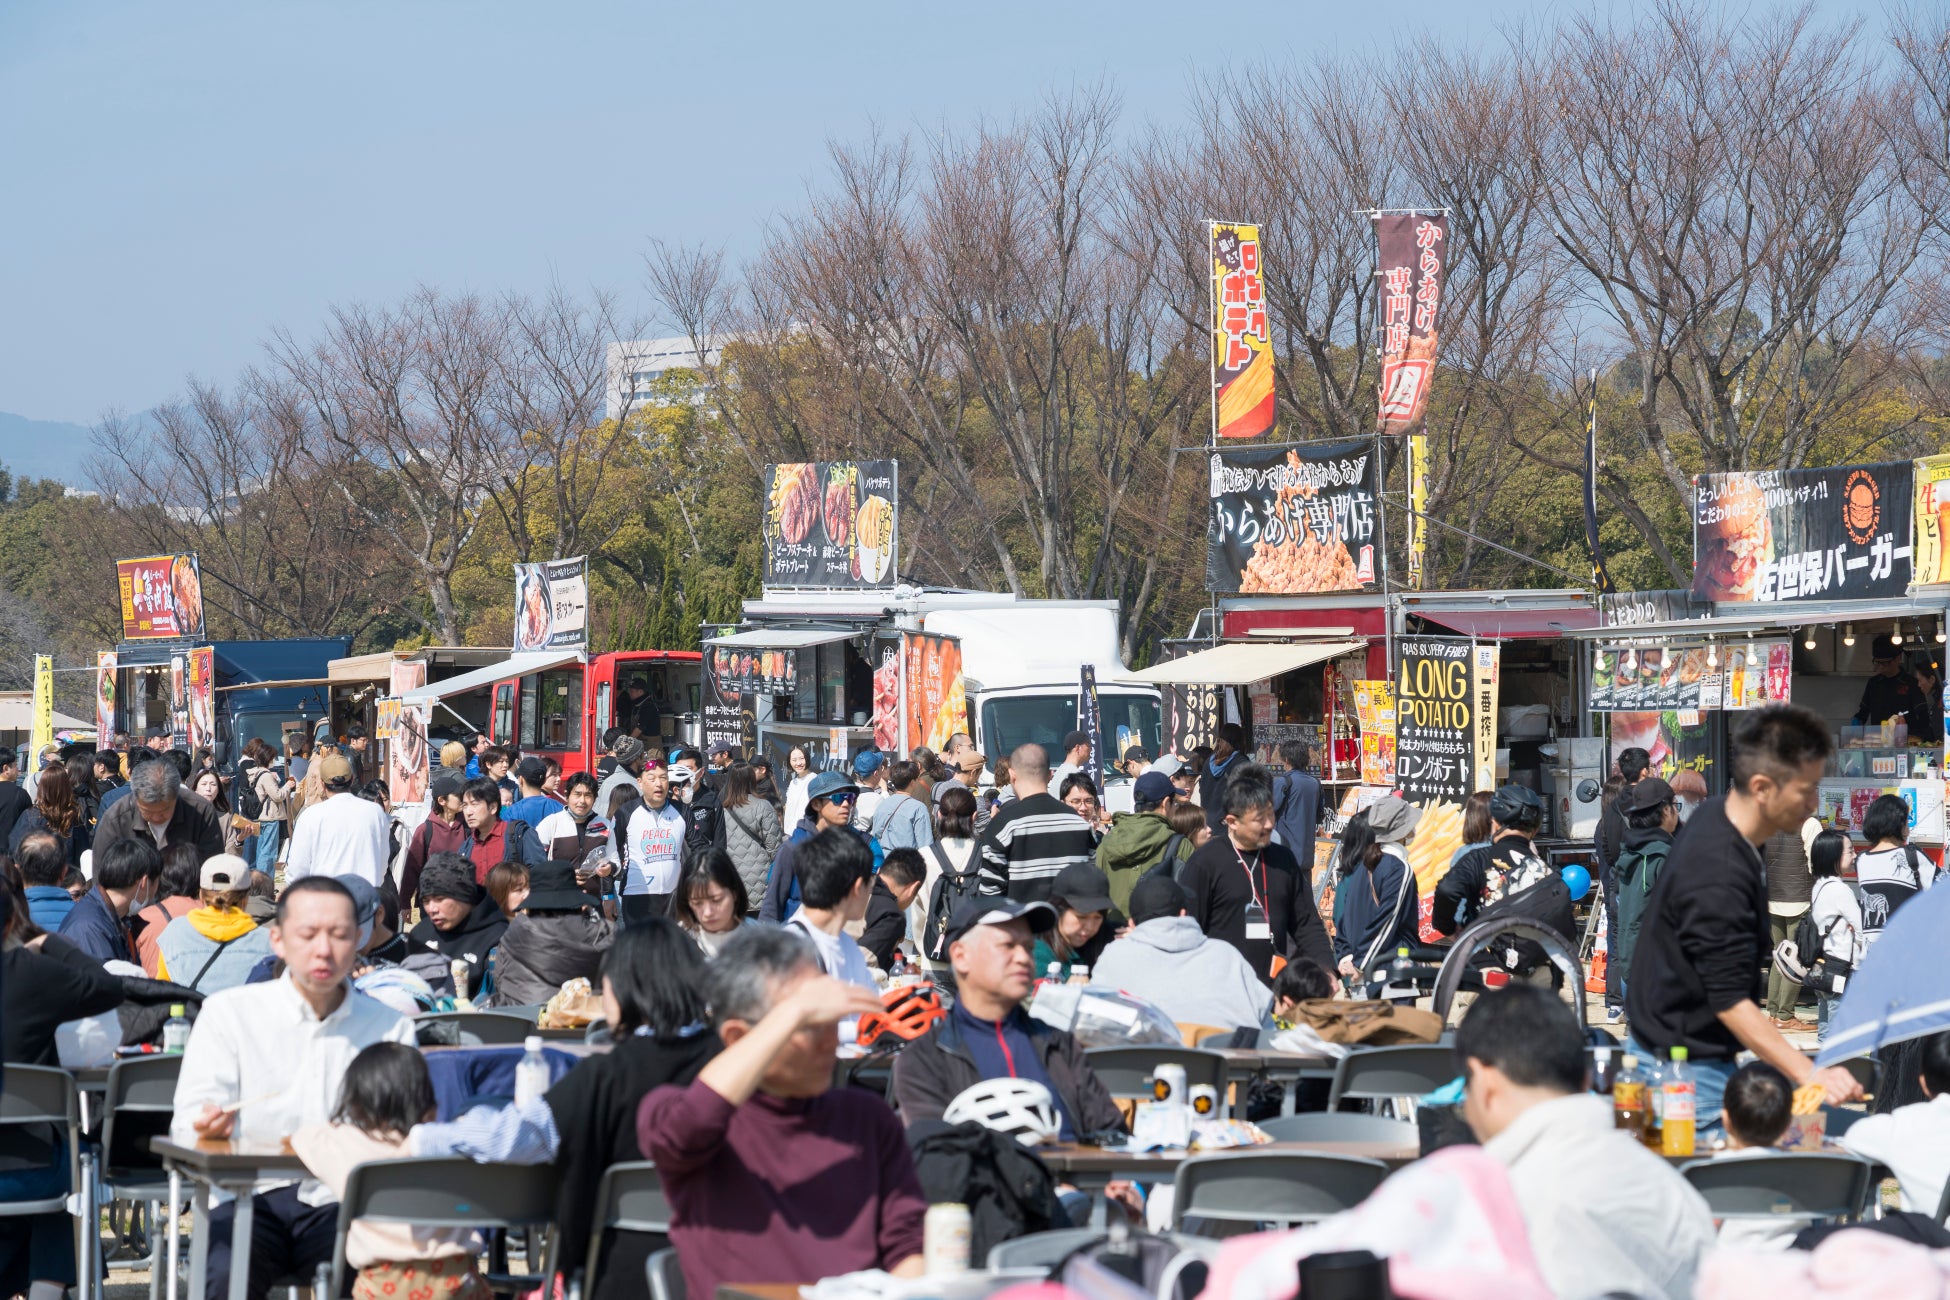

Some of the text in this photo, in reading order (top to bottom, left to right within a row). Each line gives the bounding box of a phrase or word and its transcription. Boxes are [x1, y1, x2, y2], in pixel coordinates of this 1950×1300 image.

[1226, 251, 1239, 264] たて
[1414, 221, 1442, 331] からあげ
[1222, 269, 1251, 370] ポテト
[1386, 267, 1411, 353] 専門店
[1216, 492, 1374, 546] からあげ専門店
[1920, 482, 1940, 584] 生ビール
[775, 559, 809, 575] ポテトプレート
[1753, 531, 1912, 602] 佐世保バーガー
[1402, 643, 1470, 658] RAS SUPER FRIES
[1400, 658, 1467, 700] LONG
[1398, 698, 1470, 729] POTATO
[1481, 678, 1492, 762] 一番搾り
[1397, 755, 1470, 783] ロングポテト
[642, 829, 673, 840] PEACE
[646, 844, 673, 855] SMILE
